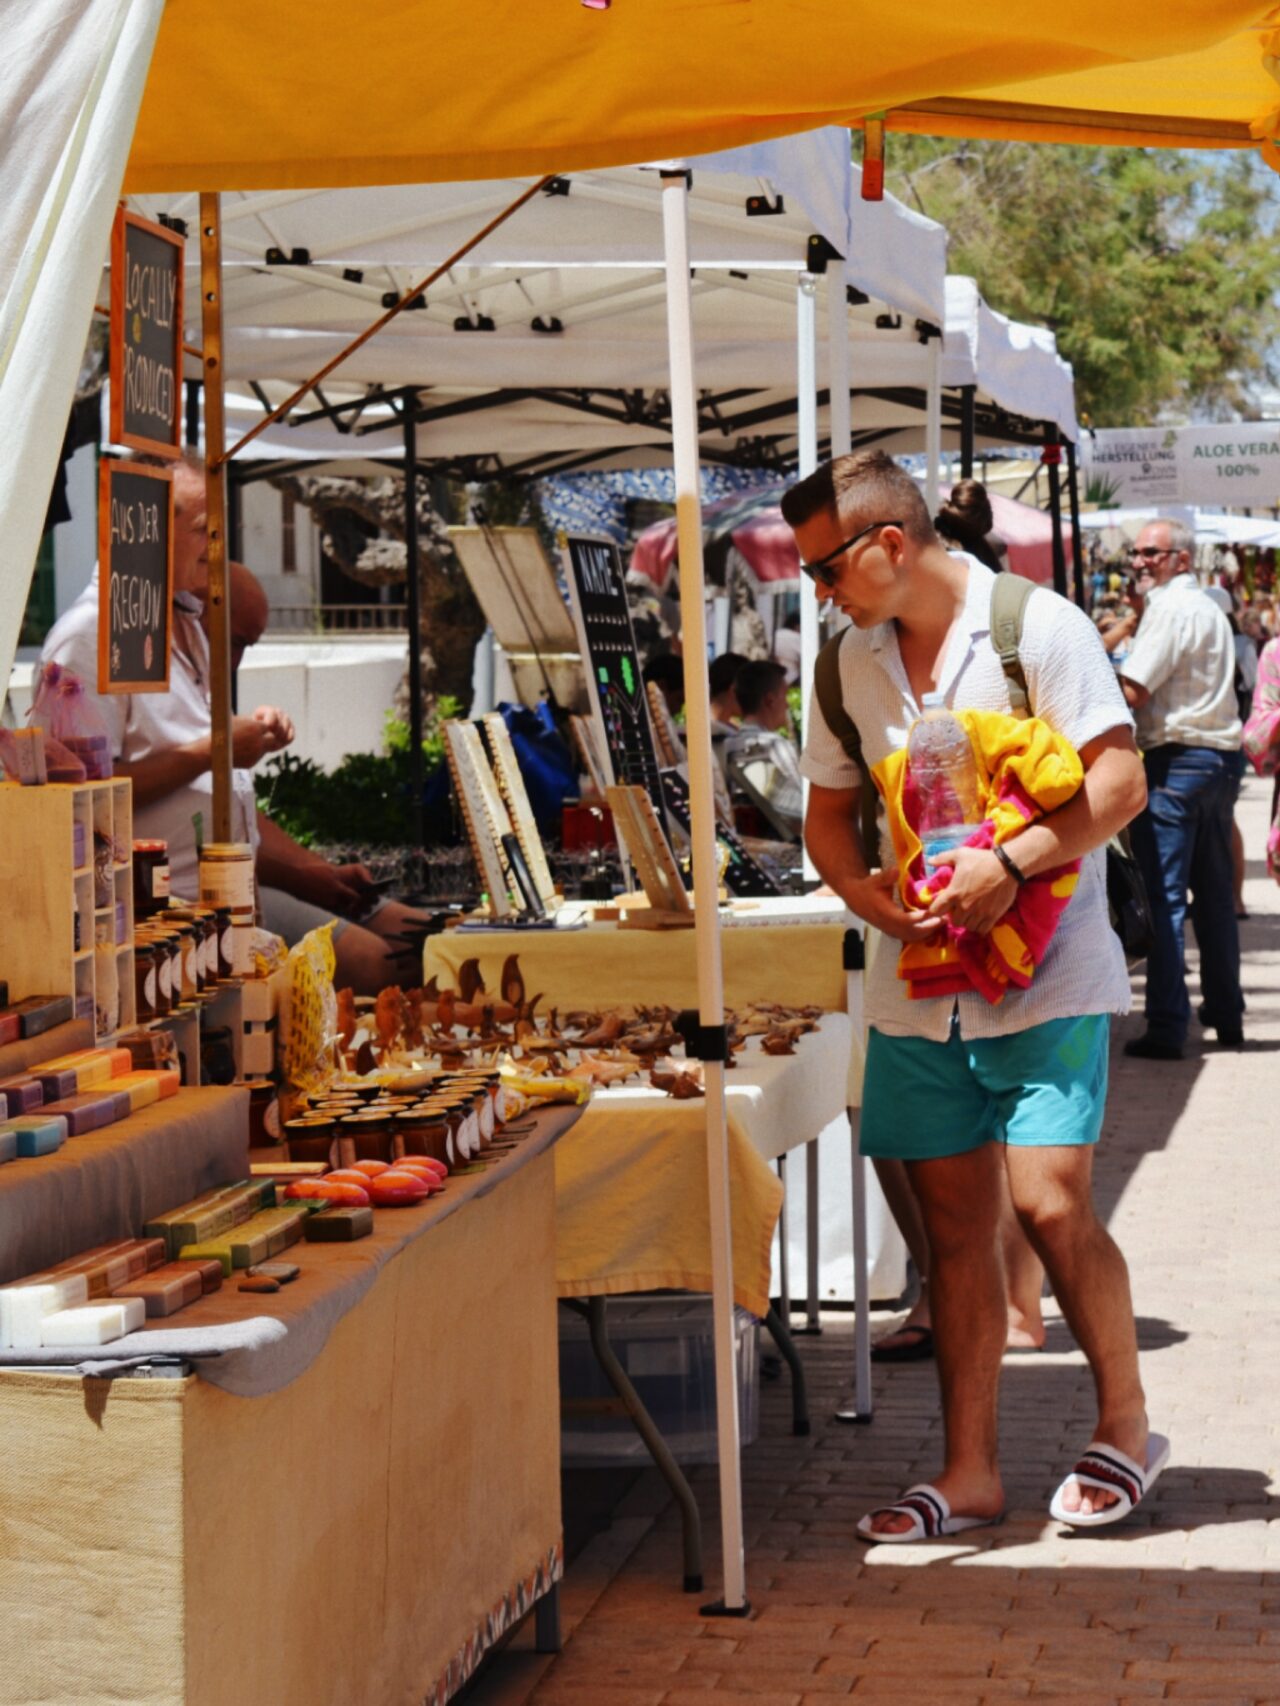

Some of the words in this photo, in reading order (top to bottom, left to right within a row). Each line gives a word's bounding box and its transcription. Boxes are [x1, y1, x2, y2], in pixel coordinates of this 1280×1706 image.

[125, 252, 177, 330] LOCALLY
[124, 342, 175, 426] PRODUCED
[1092, 451, 1176, 463] HERSTELLUNG
[1193, 444, 1234, 459] ALOE
[1238, 442, 1280, 456] VERA
[1215, 464, 1260, 478] 100%
[111, 498, 135, 544] AUS
[138, 501, 159, 543] DER
[577, 545, 618, 596] NAME
[111, 571, 162, 633] REGION
